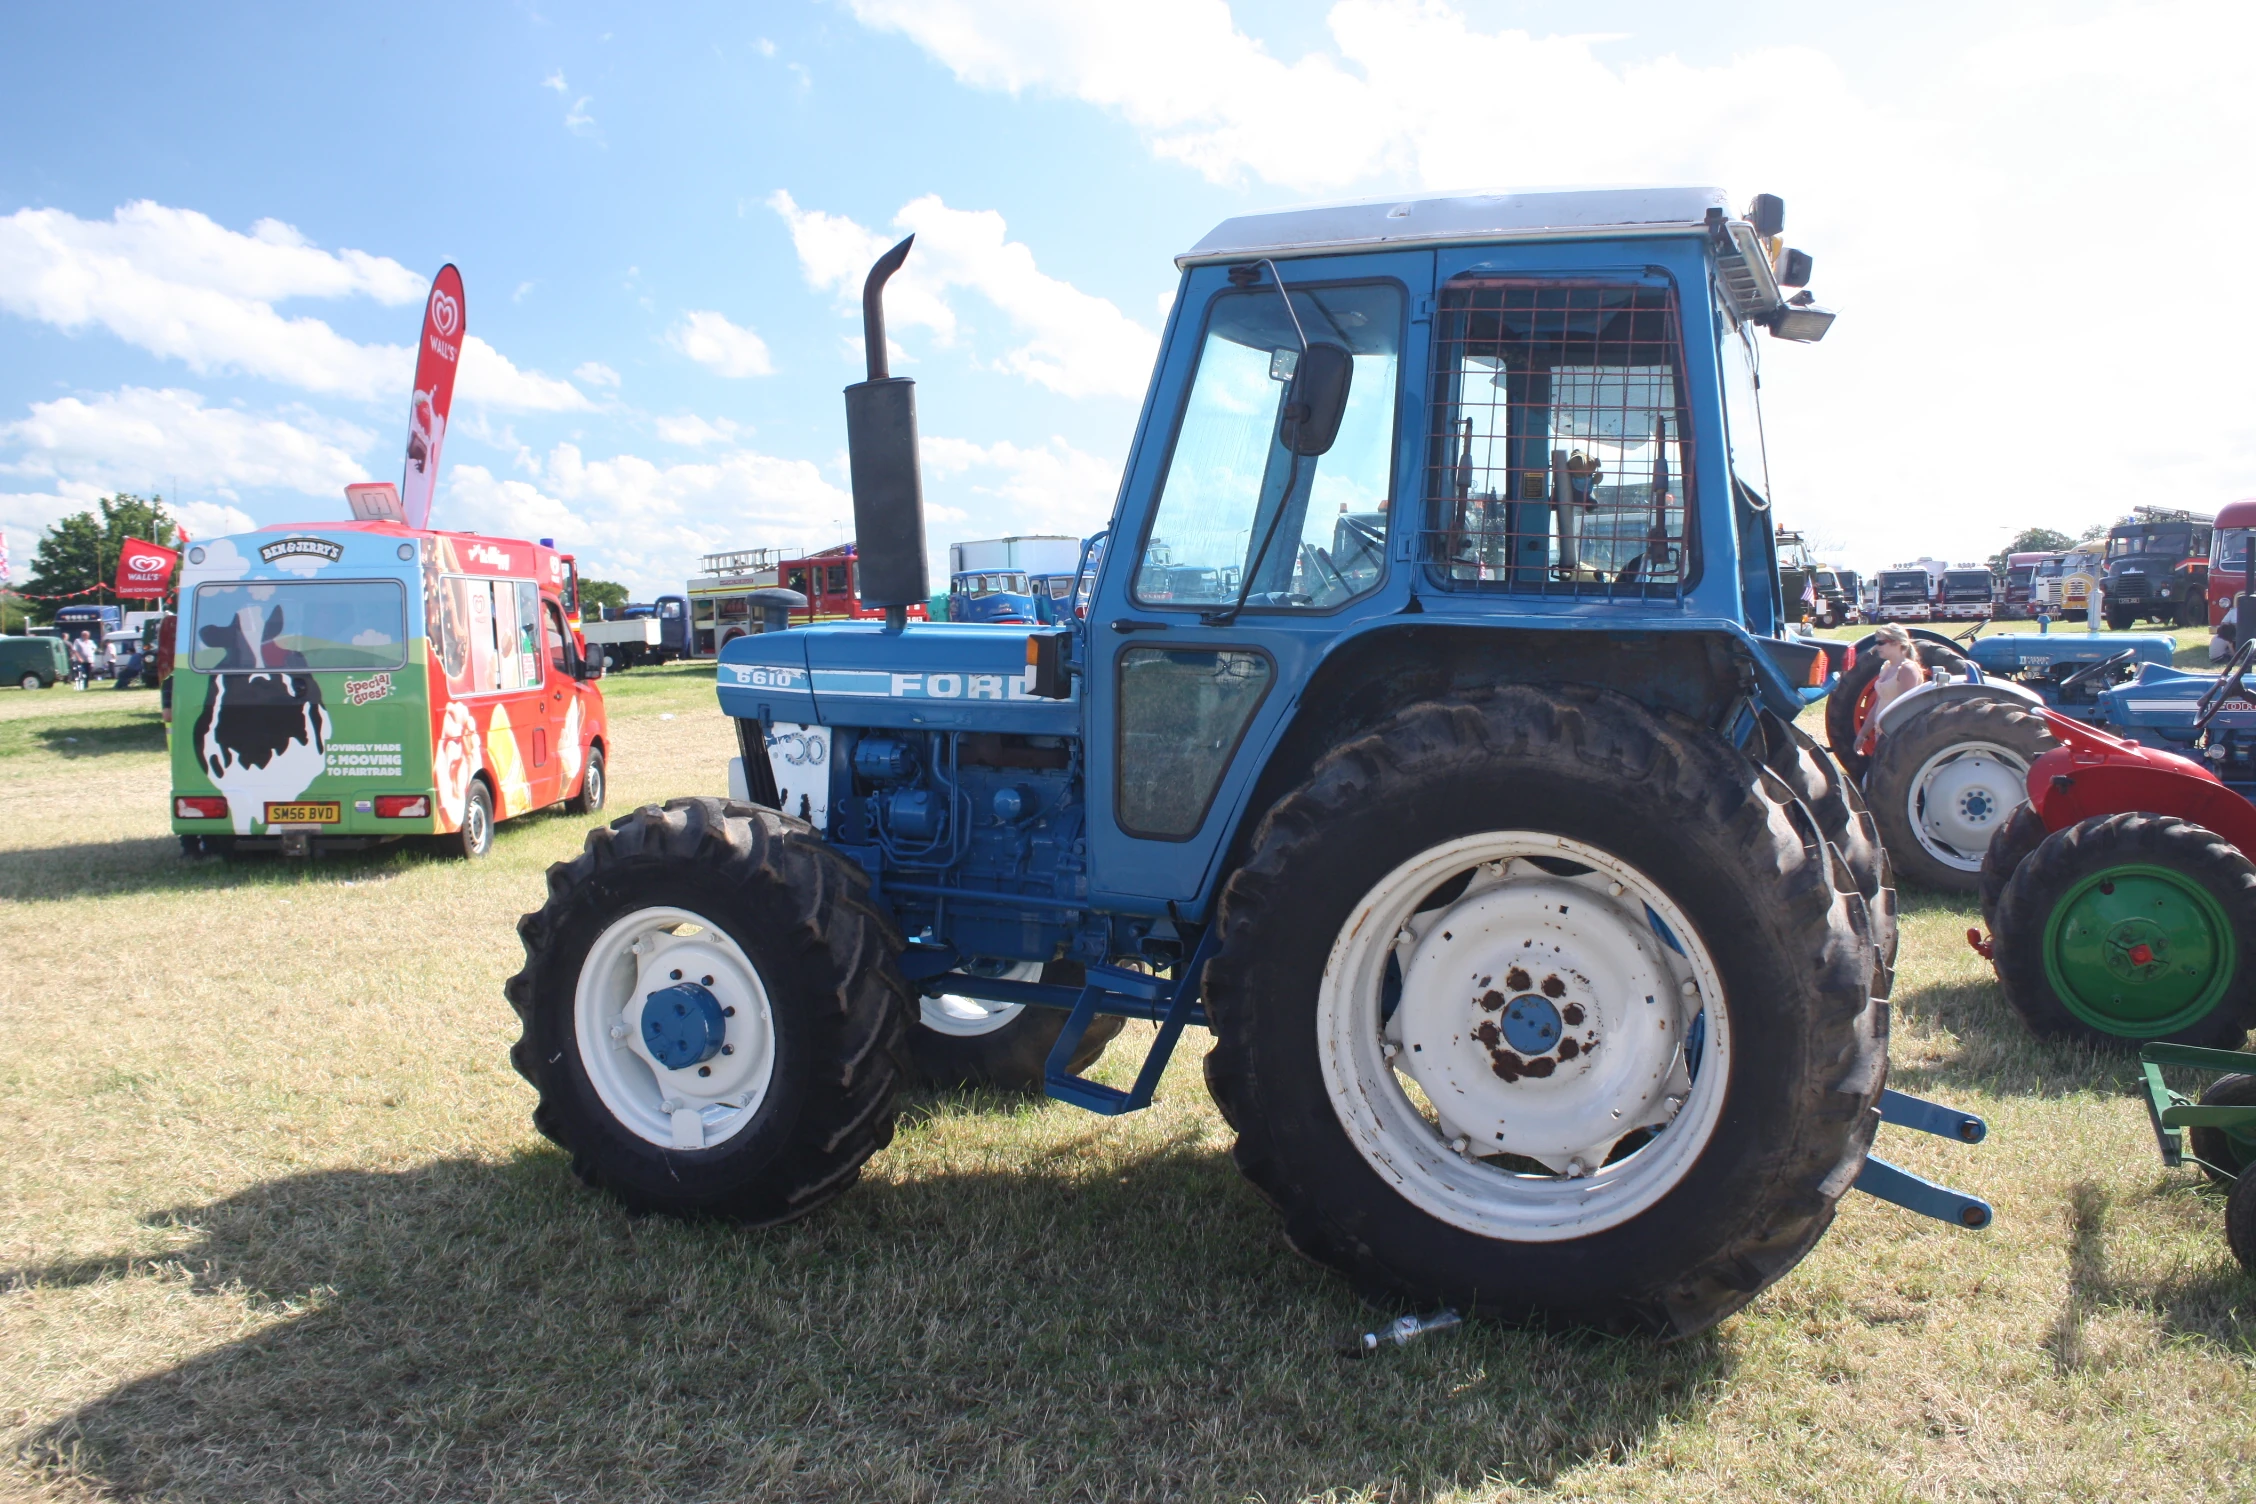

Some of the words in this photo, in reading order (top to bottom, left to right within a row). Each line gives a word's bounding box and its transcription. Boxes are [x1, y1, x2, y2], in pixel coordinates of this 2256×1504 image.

[430, 335, 456, 362] WALL'S
[262, 543, 287, 560] BEN
[296, 541, 339, 558] JERRY'S
[127, 573, 160, 581] WALL'S
[345, 674, 390, 694] Special
[736, 671, 791, 686] 6610
[891, 673, 1042, 700] FORD
[353, 686, 387, 705] Guest
[326, 743, 372, 752] LOVINGLY
[373, 743, 402, 752] MADE
[326, 754, 337, 766] &
[338, 754, 402, 766] MOOVING
[326, 767, 341, 776] TO
[342, 767, 402, 776] FAIRTRADE
[273, 807, 306, 820] SM56
[308, 807, 333, 820] BVD
